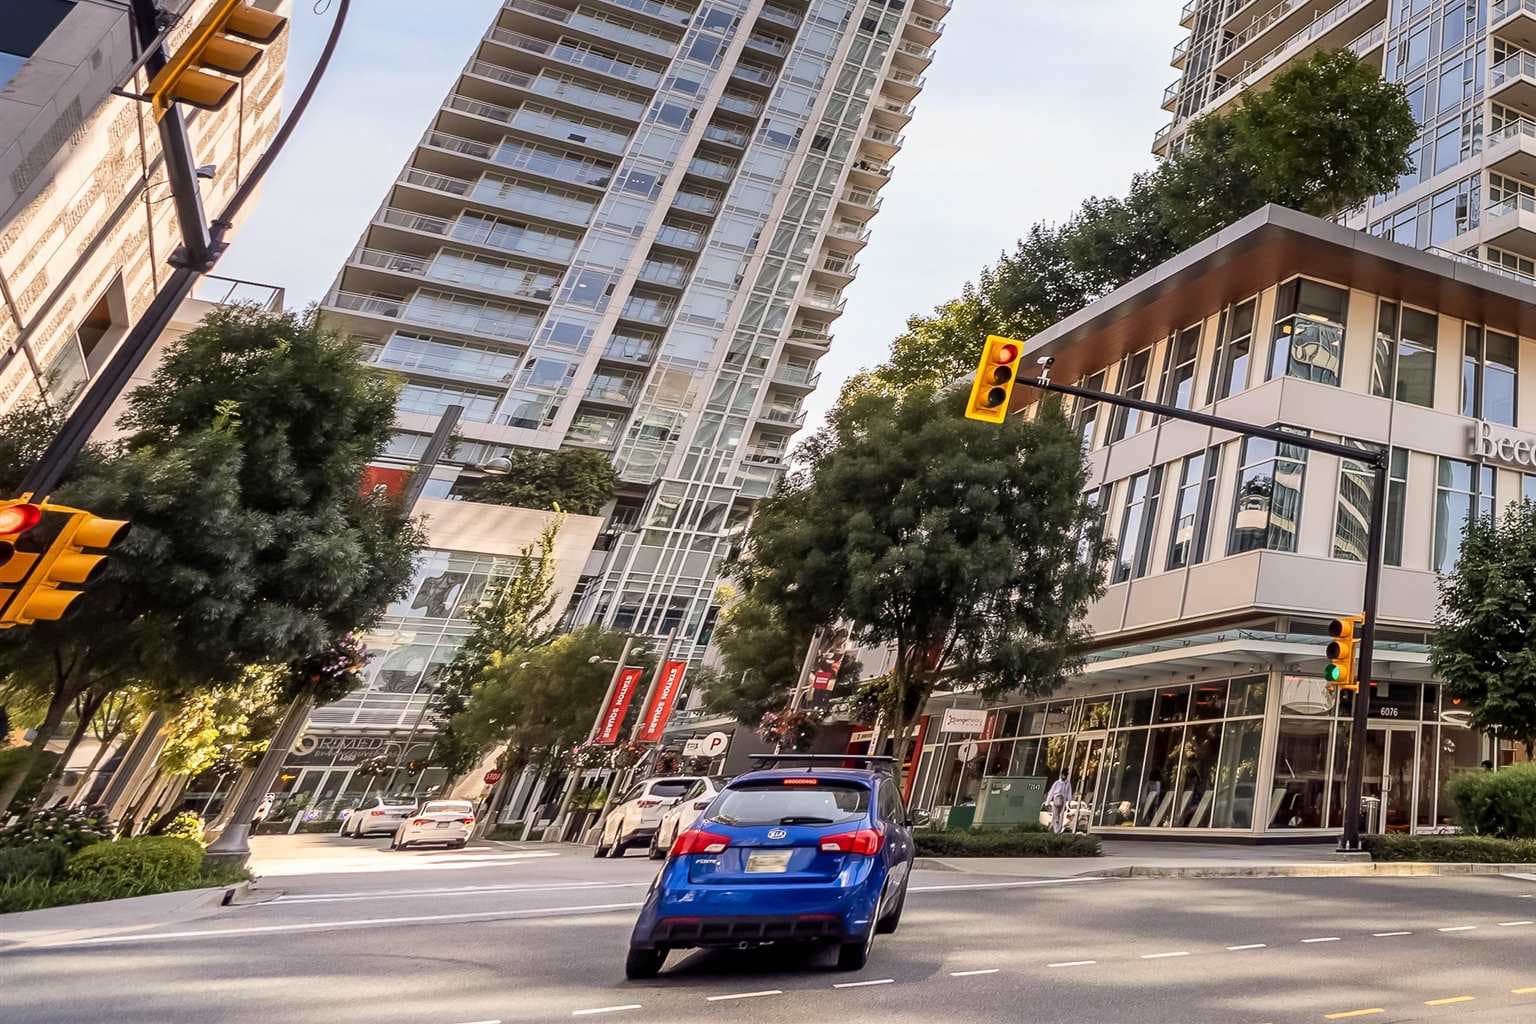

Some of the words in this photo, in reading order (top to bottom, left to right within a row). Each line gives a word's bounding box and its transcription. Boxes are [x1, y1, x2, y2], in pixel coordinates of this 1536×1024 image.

[615, 675, 633, 706] STATION
[661, 668, 678, 700] STATION
[603, 707, 620, 738] SQUARE
[648, 701, 665, 734] SQUARE
[1380, 707, 1399, 717] 6076
[710, 737, 722, 750] P
